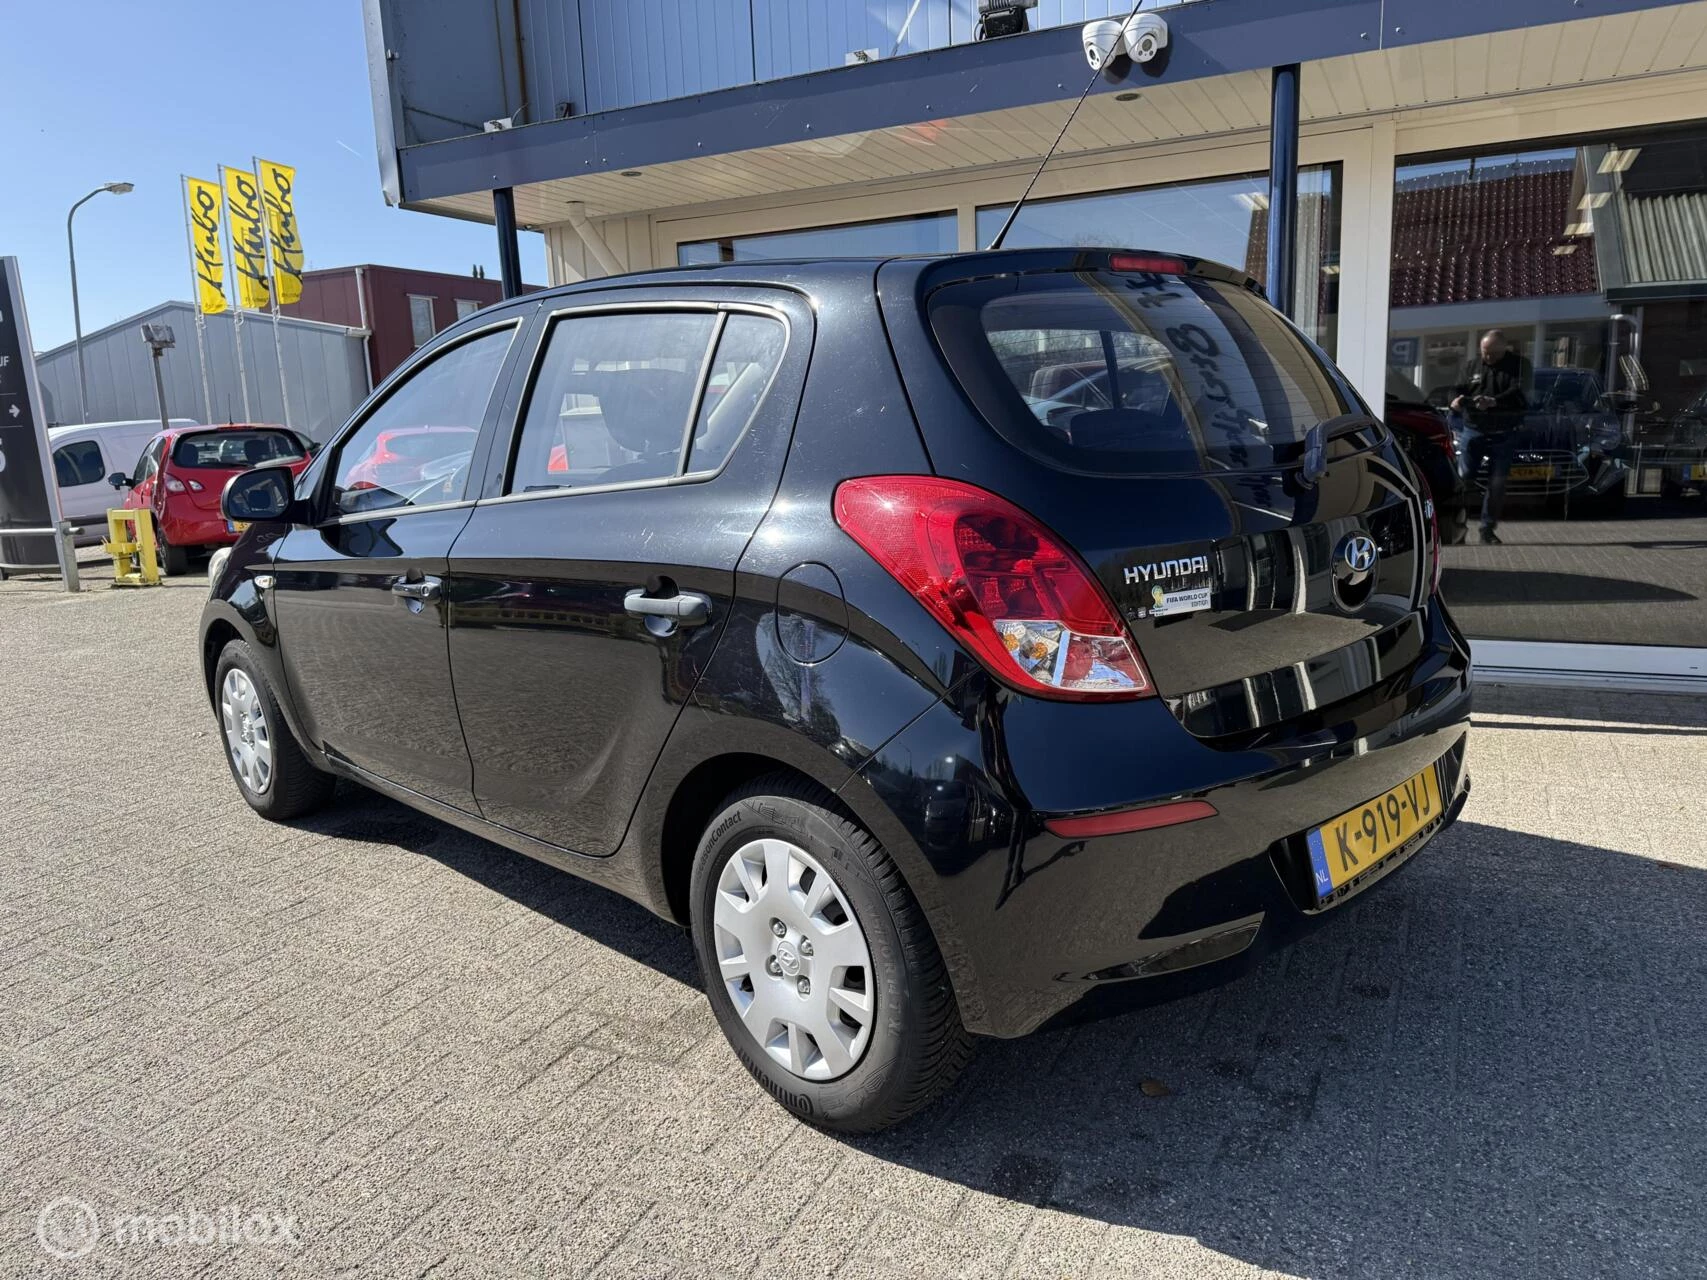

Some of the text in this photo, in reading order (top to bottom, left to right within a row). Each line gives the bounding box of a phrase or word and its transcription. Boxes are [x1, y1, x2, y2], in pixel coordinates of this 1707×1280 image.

[1123, 555, 1208, 585] HYUNDAI
[1166, 592, 1208, 604] FIFA WORLD CUP
[1335, 773, 1430, 872] K-919-VJ
[1315, 872, 1329, 885] NL
